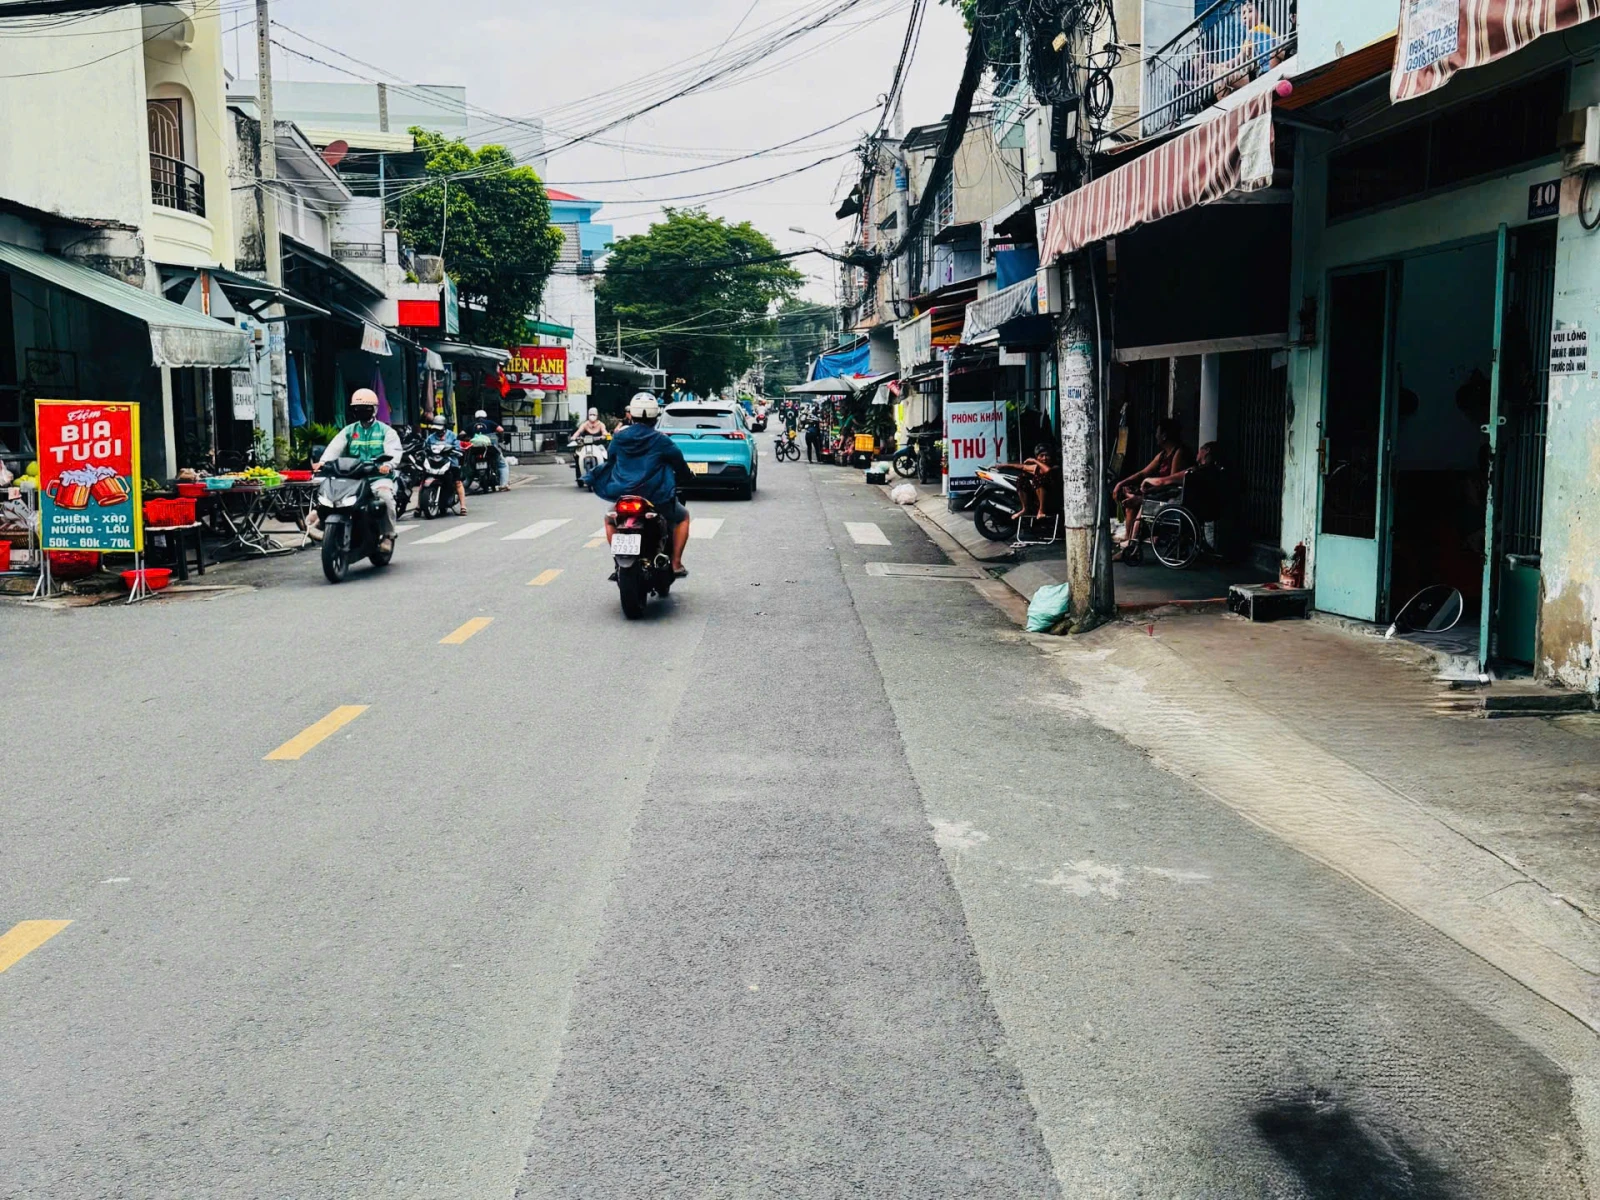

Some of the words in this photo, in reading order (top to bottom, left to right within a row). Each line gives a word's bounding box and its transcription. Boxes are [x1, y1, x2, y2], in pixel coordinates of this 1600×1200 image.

[1532, 183, 1556, 207] 40
[1553, 333, 1565, 342] VUI
[1567, 330, 1586, 341] LÒNG
[533, 354, 565, 374] LÀNH
[67, 409, 101, 422] Tiệm
[951, 411, 978, 423] PHÒNG
[61, 420, 111, 443] BIA
[49, 438, 122, 464] TƯƠI
[951, 432, 986, 459] THÚ
[993, 436, 1004, 458] Y
[48, 537, 69, 548] 50k
[79, 537, 100, 548] 60k
[110, 538, 131, 548] 70k
